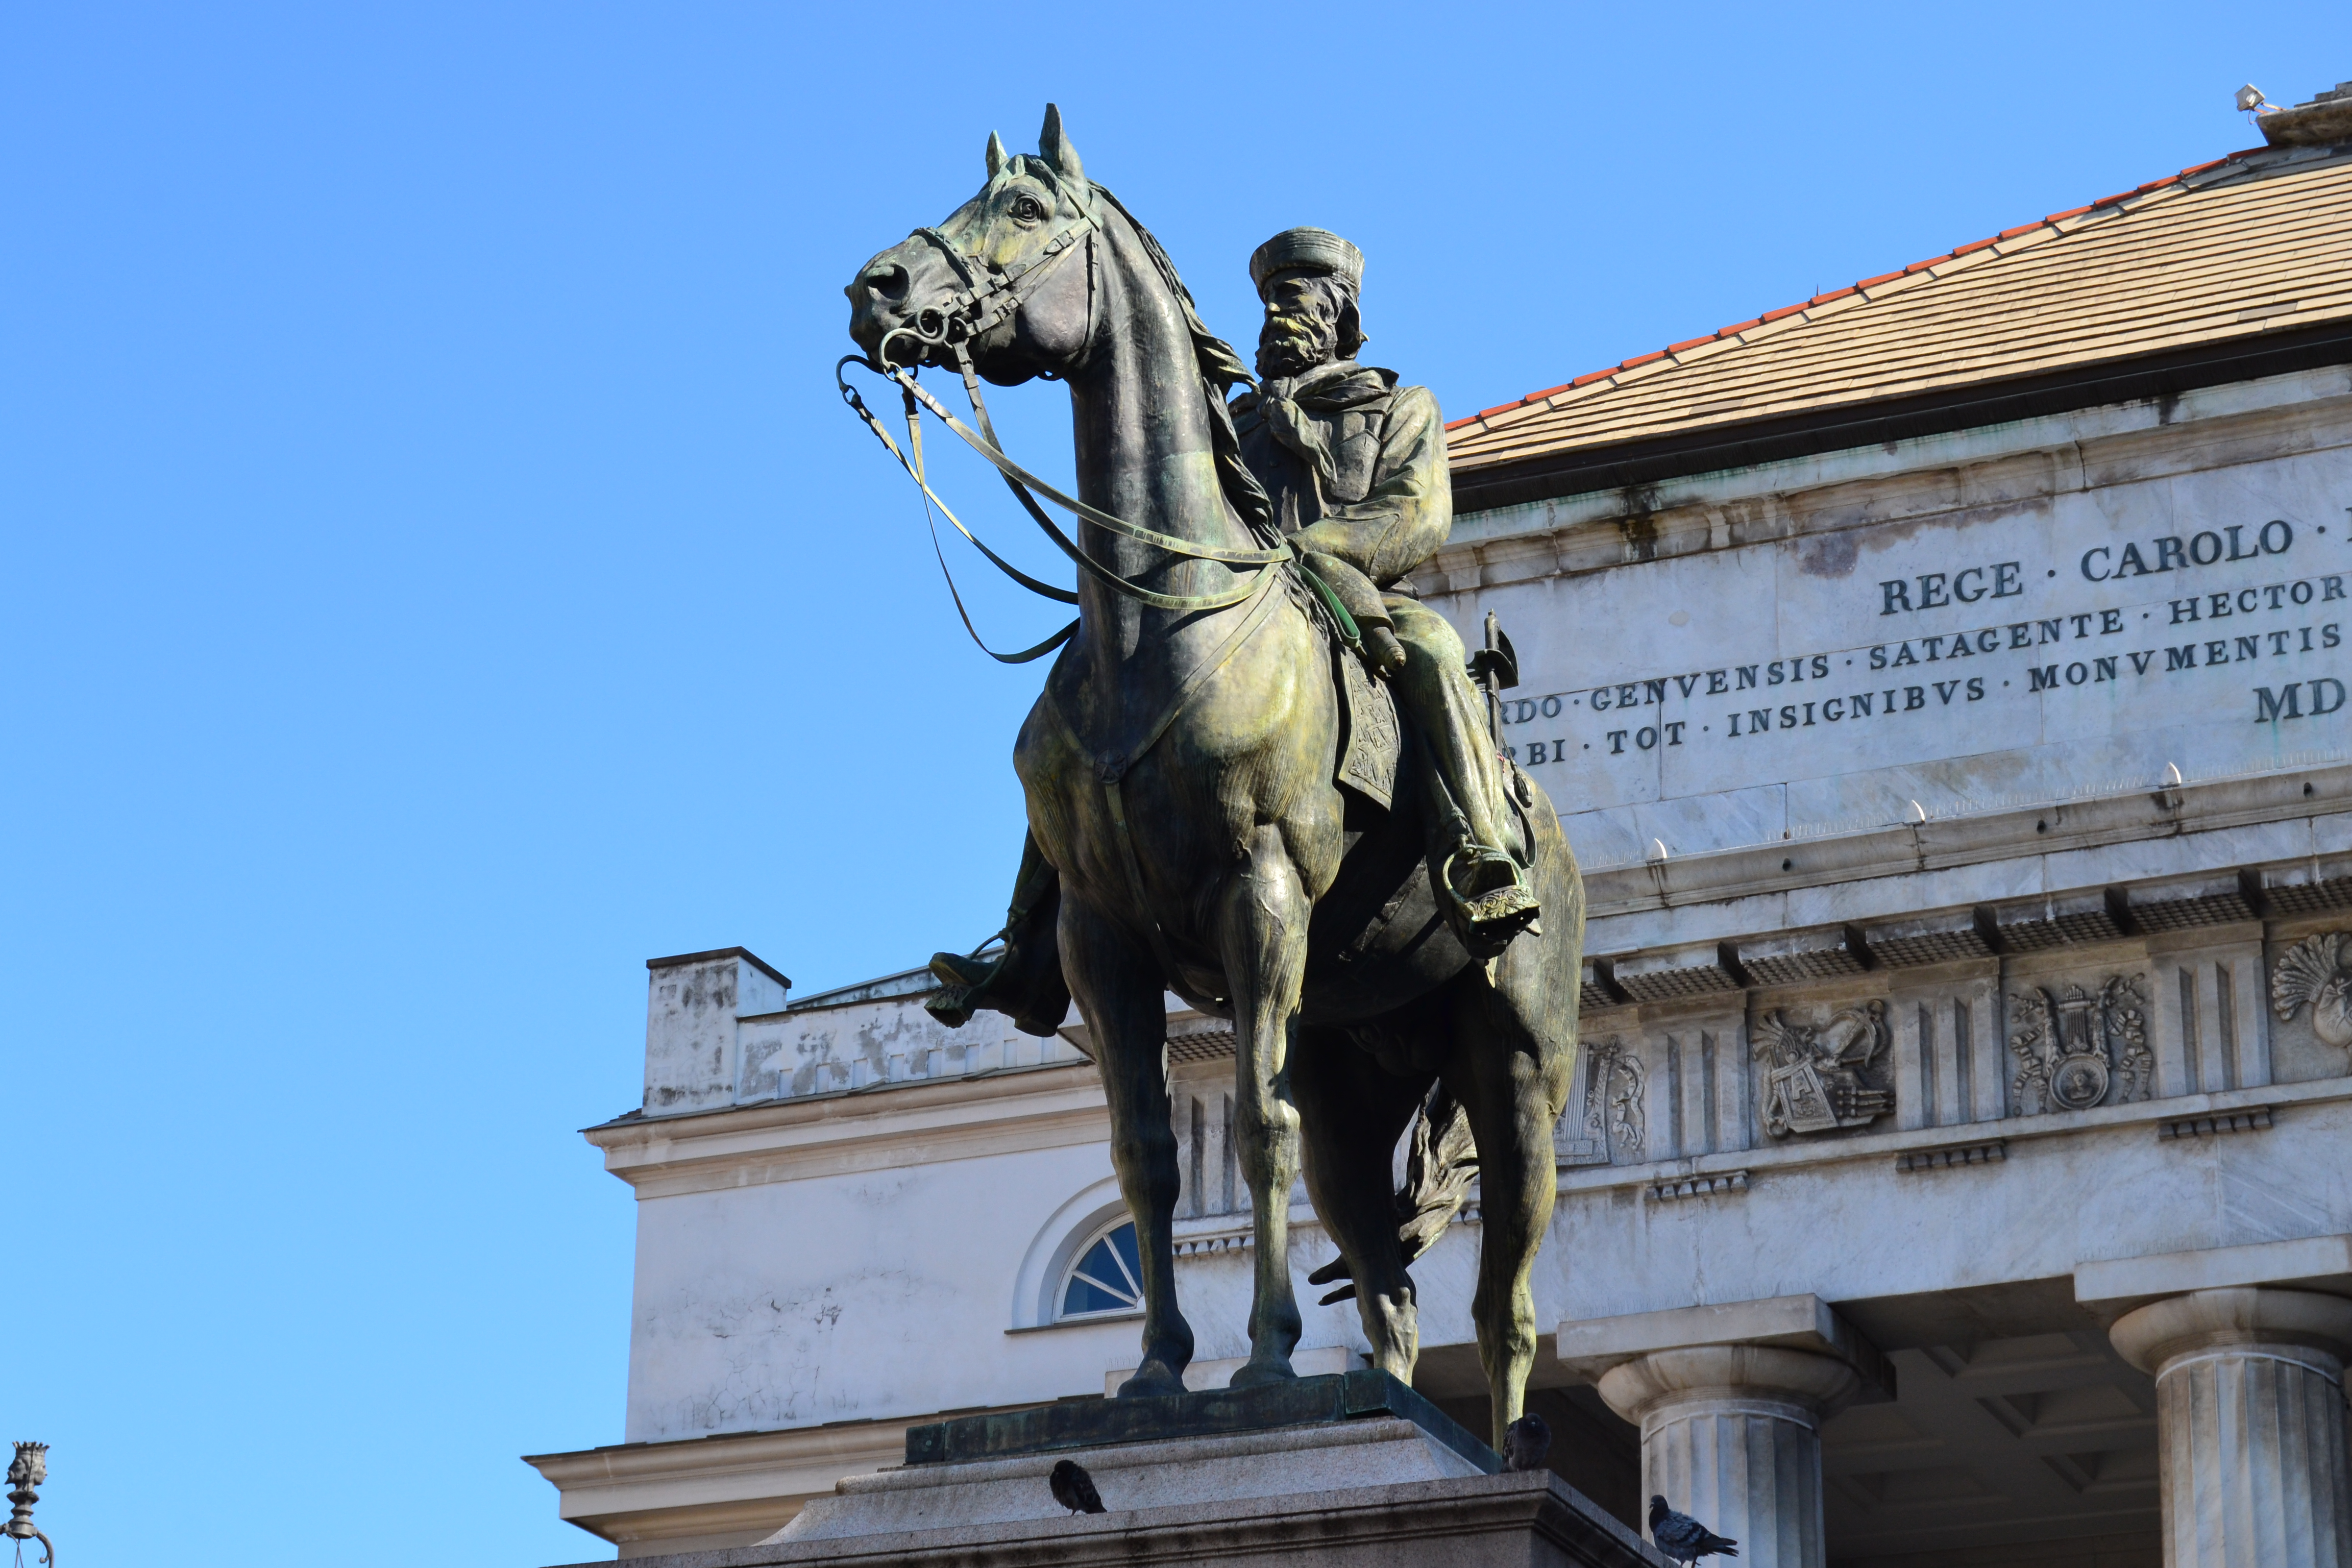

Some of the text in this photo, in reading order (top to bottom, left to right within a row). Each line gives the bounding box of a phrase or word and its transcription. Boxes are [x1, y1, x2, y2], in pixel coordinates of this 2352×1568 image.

[1878, 561, 2023, 616] REGE
[2080, 520, 2293, 582] CAROLO
[1590, 654, 1829, 713] GENVENSIS
[1854, 608, 2124, 670] SATAGENTE
[2168, 575, 2347, 625] HECTOR
[1607, 721, 1686, 755] TOT
[1727, 677, 1984, 738] INSIGNIBVS
[2027, 623, 2341, 693] MONVMENTIS
[2252, 677, 2346, 724] MD
